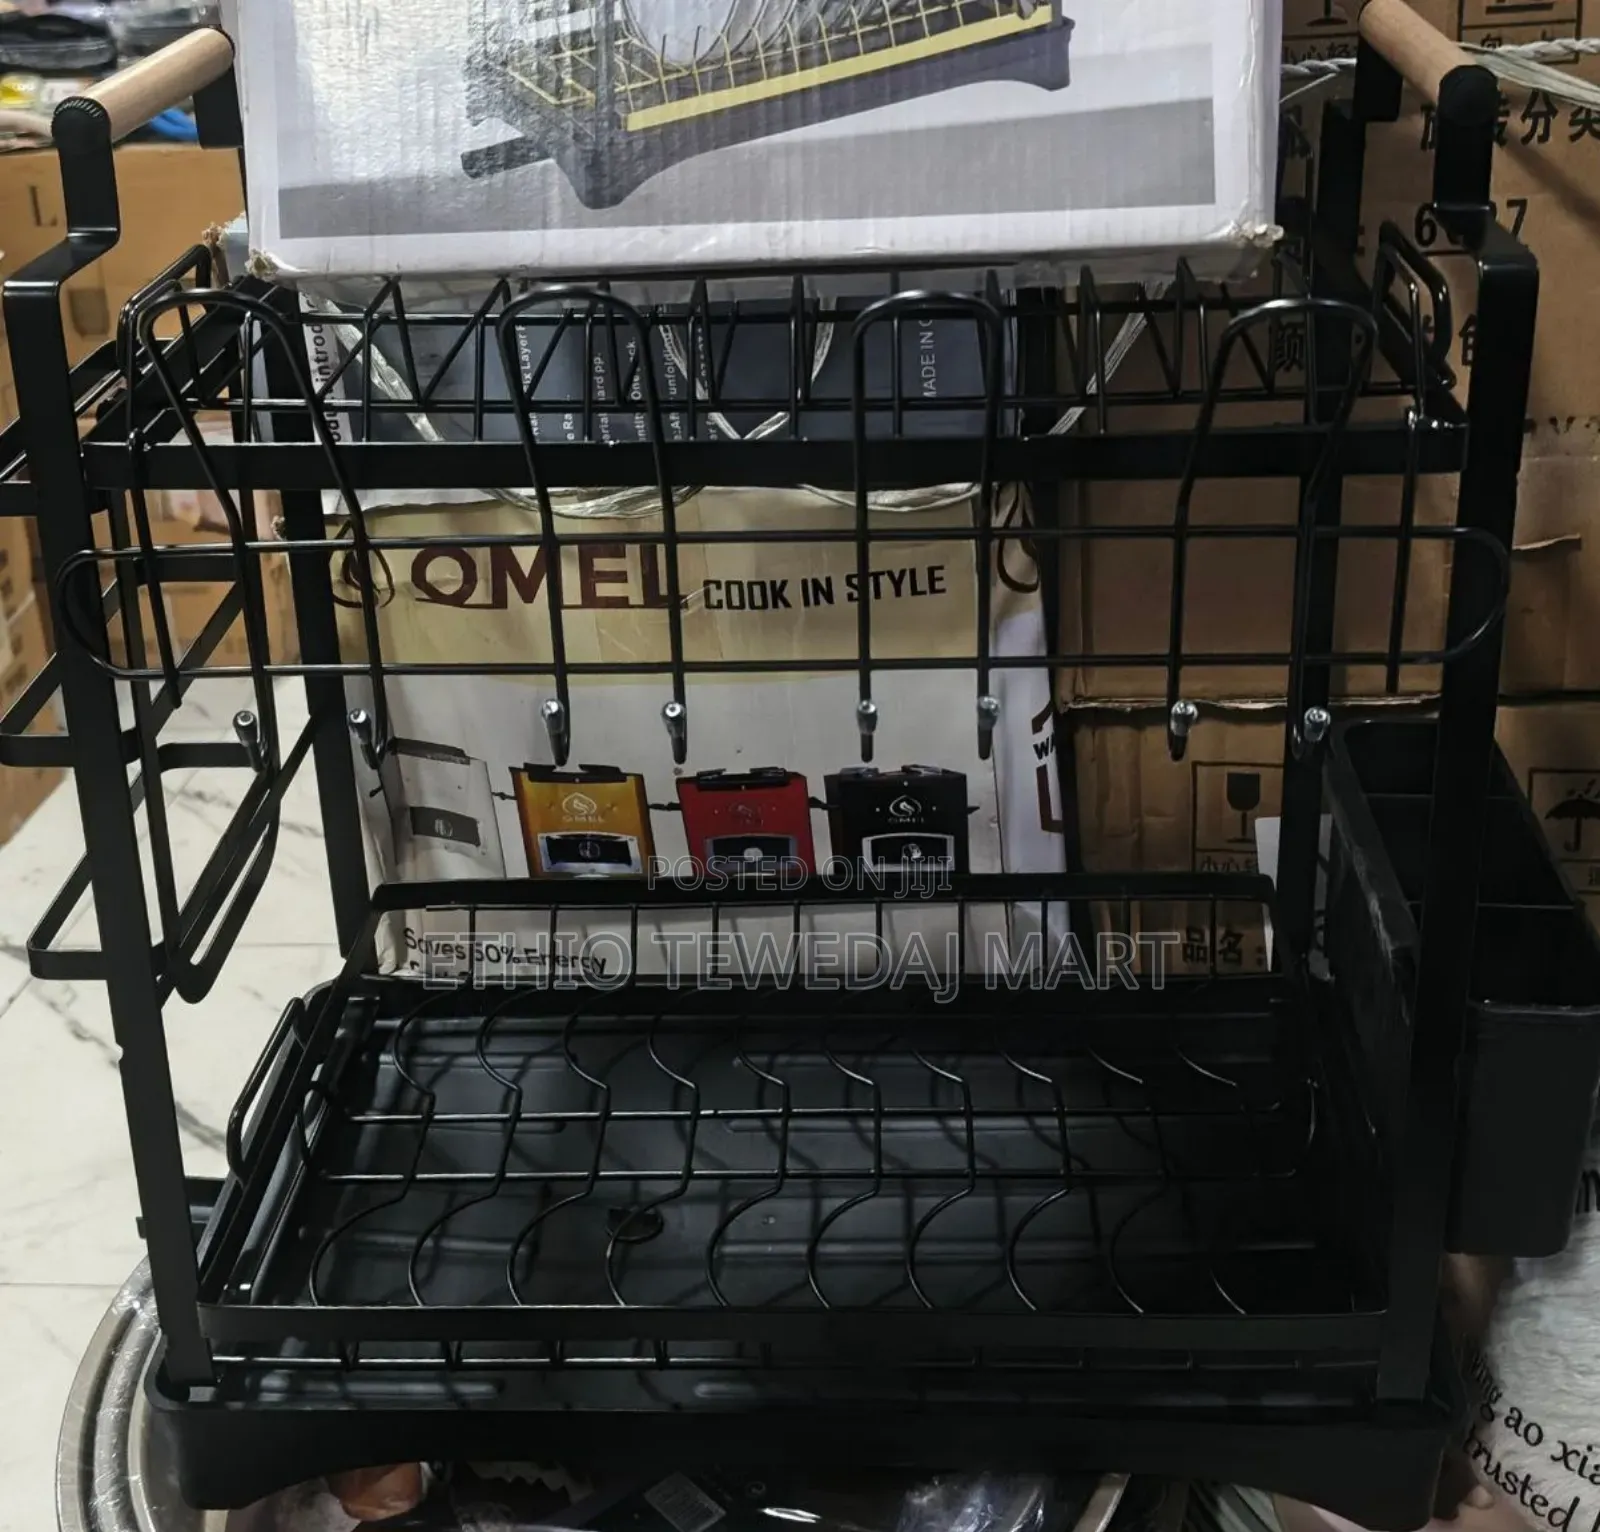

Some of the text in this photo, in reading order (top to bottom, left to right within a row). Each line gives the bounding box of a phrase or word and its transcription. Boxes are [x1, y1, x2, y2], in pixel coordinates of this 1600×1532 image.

[519, 334, 532, 370] Layer
[919, 331, 935, 350] IN
[702, 565, 947, 610] COOK IN STYLE
[403, 927, 467, 960] Saves
[474, 943, 522, 965] 50%
